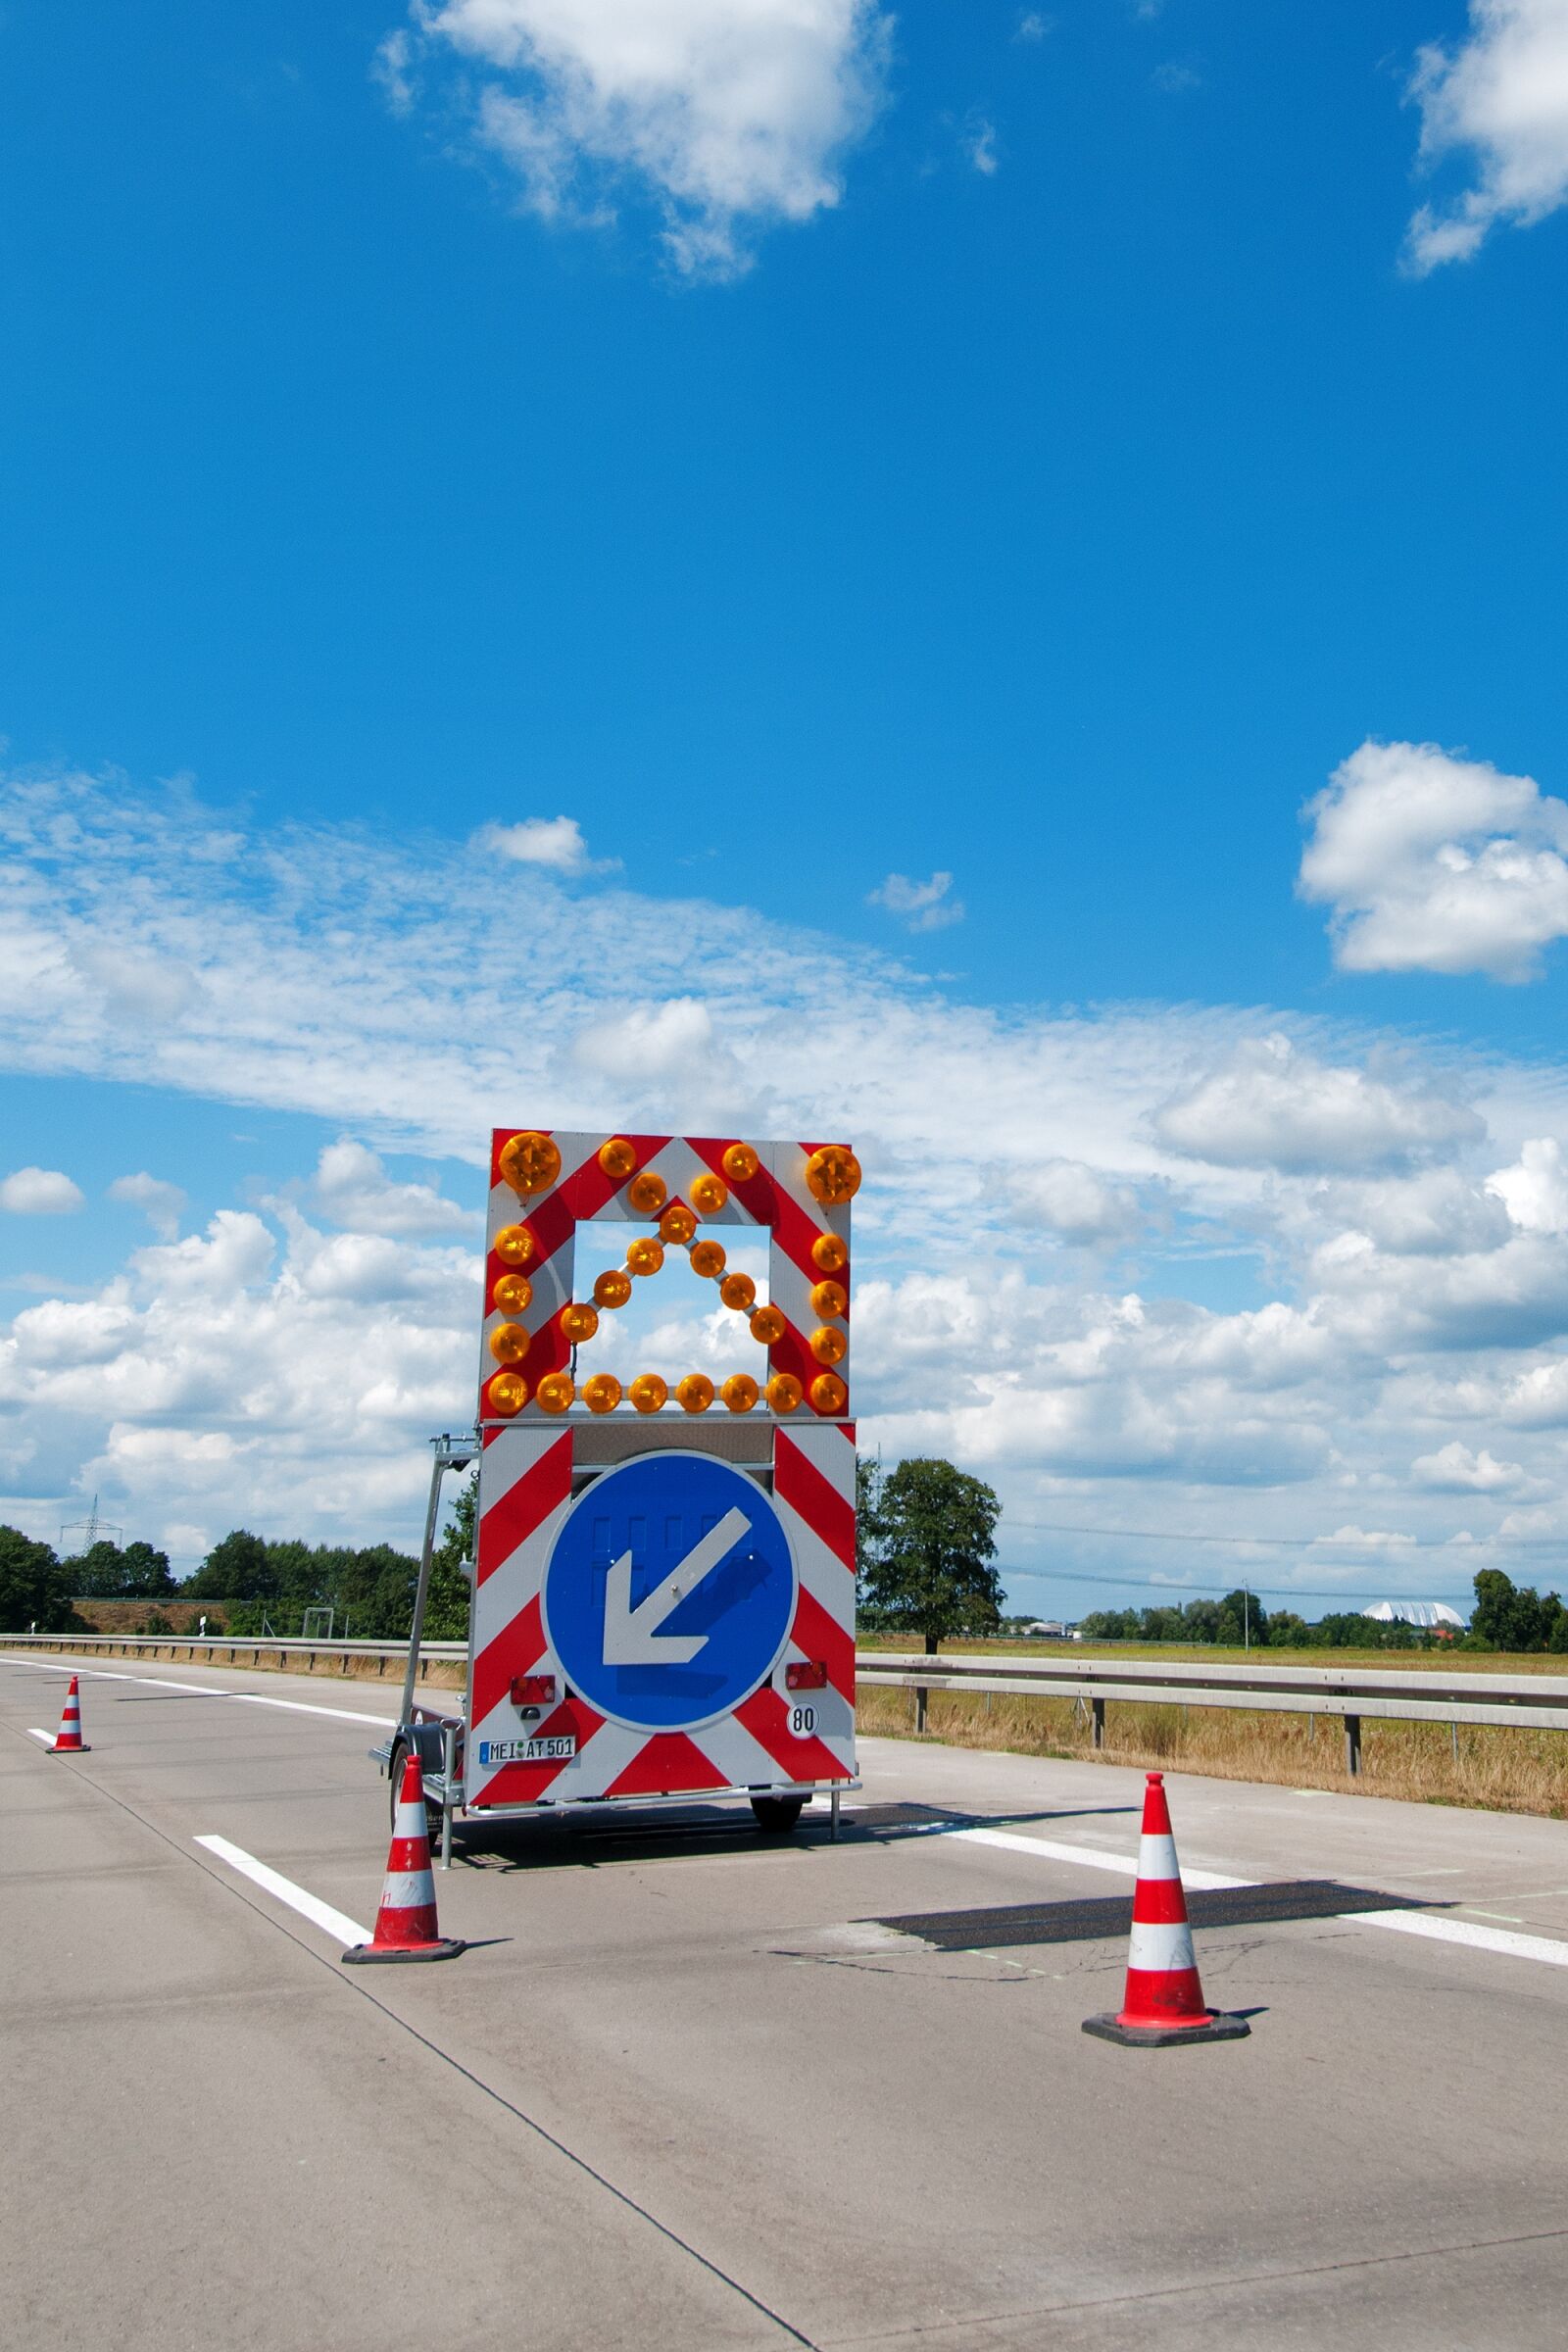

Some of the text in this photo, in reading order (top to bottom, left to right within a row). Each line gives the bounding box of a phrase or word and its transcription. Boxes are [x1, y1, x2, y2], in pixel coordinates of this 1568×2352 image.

[793, 1707, 814, 1732] 80
[490, 1739, 572, 1760] MEI AT 501
